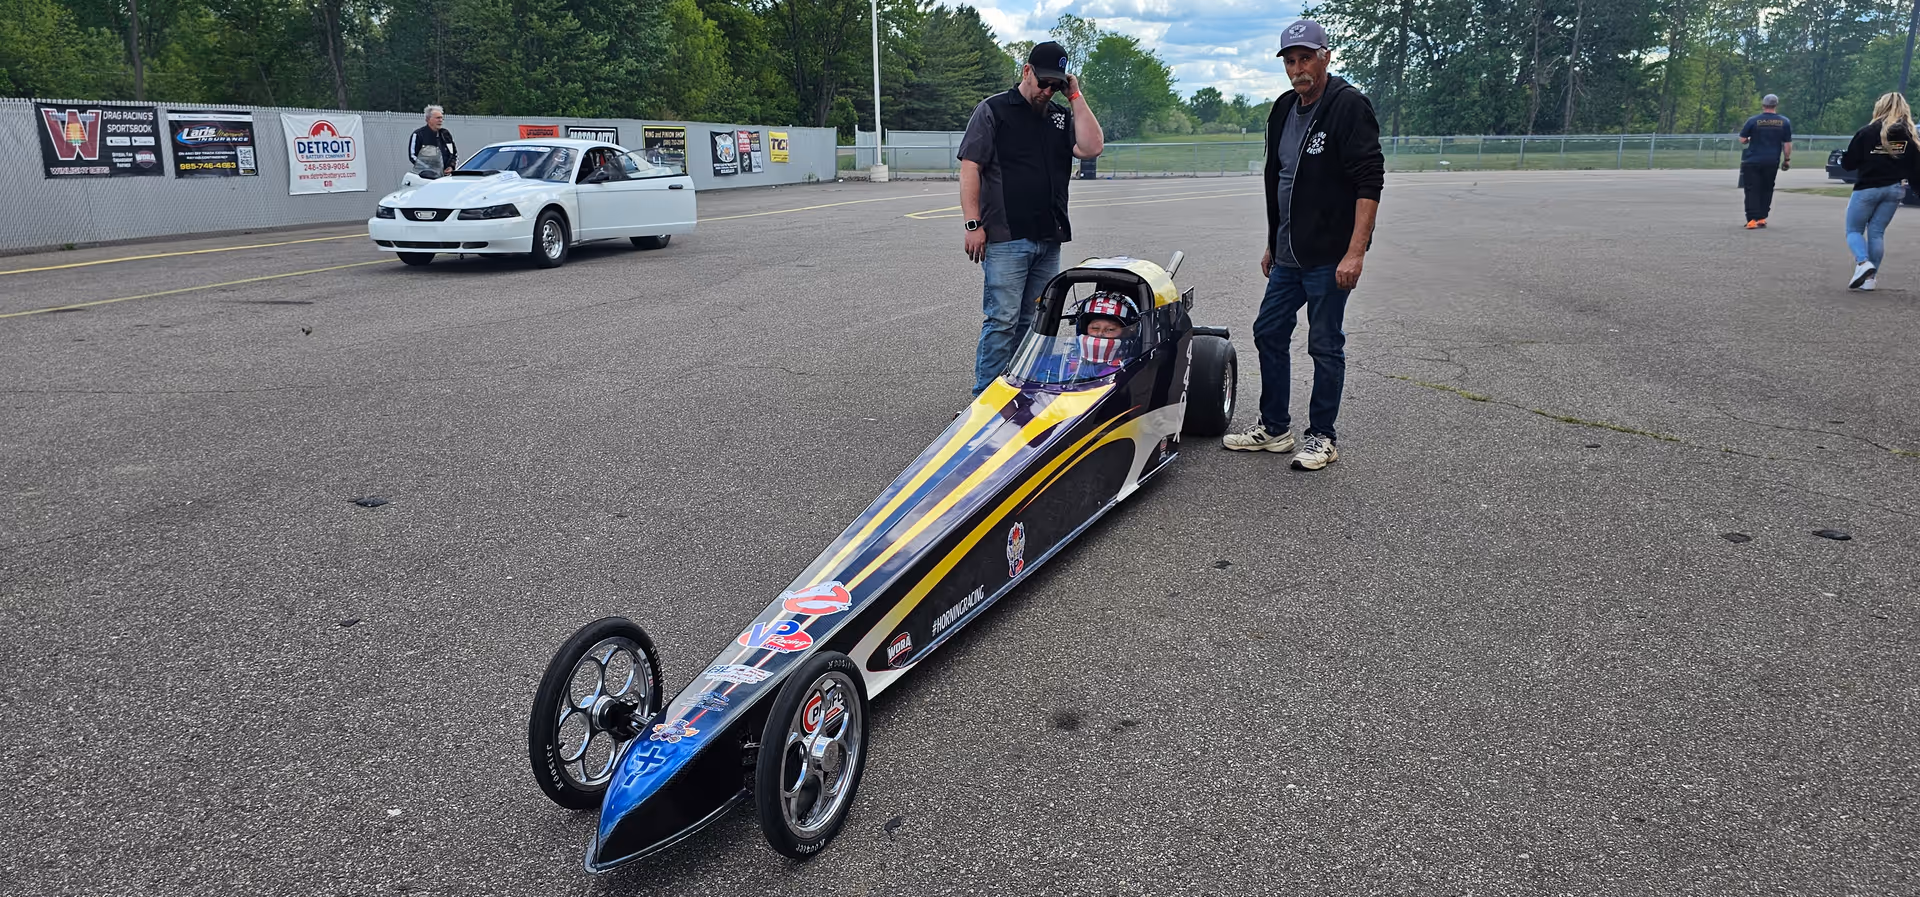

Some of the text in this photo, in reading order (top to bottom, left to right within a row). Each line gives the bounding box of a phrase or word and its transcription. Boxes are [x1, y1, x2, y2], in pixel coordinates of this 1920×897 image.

[103, 111, 154, 121] DRAG RACING'S
[107, 124, 152, 133] SPORTSBOOK
[182, 127, 216, 140] Laris
[297, 140, 351, 154] DETROIT
[932, 584, 985, 637] #HORNINGRACING
[746, 620, 800, 648] VP
[773, 636, 811, 649] Racing
[887, 635, 911, 660] WDRA
